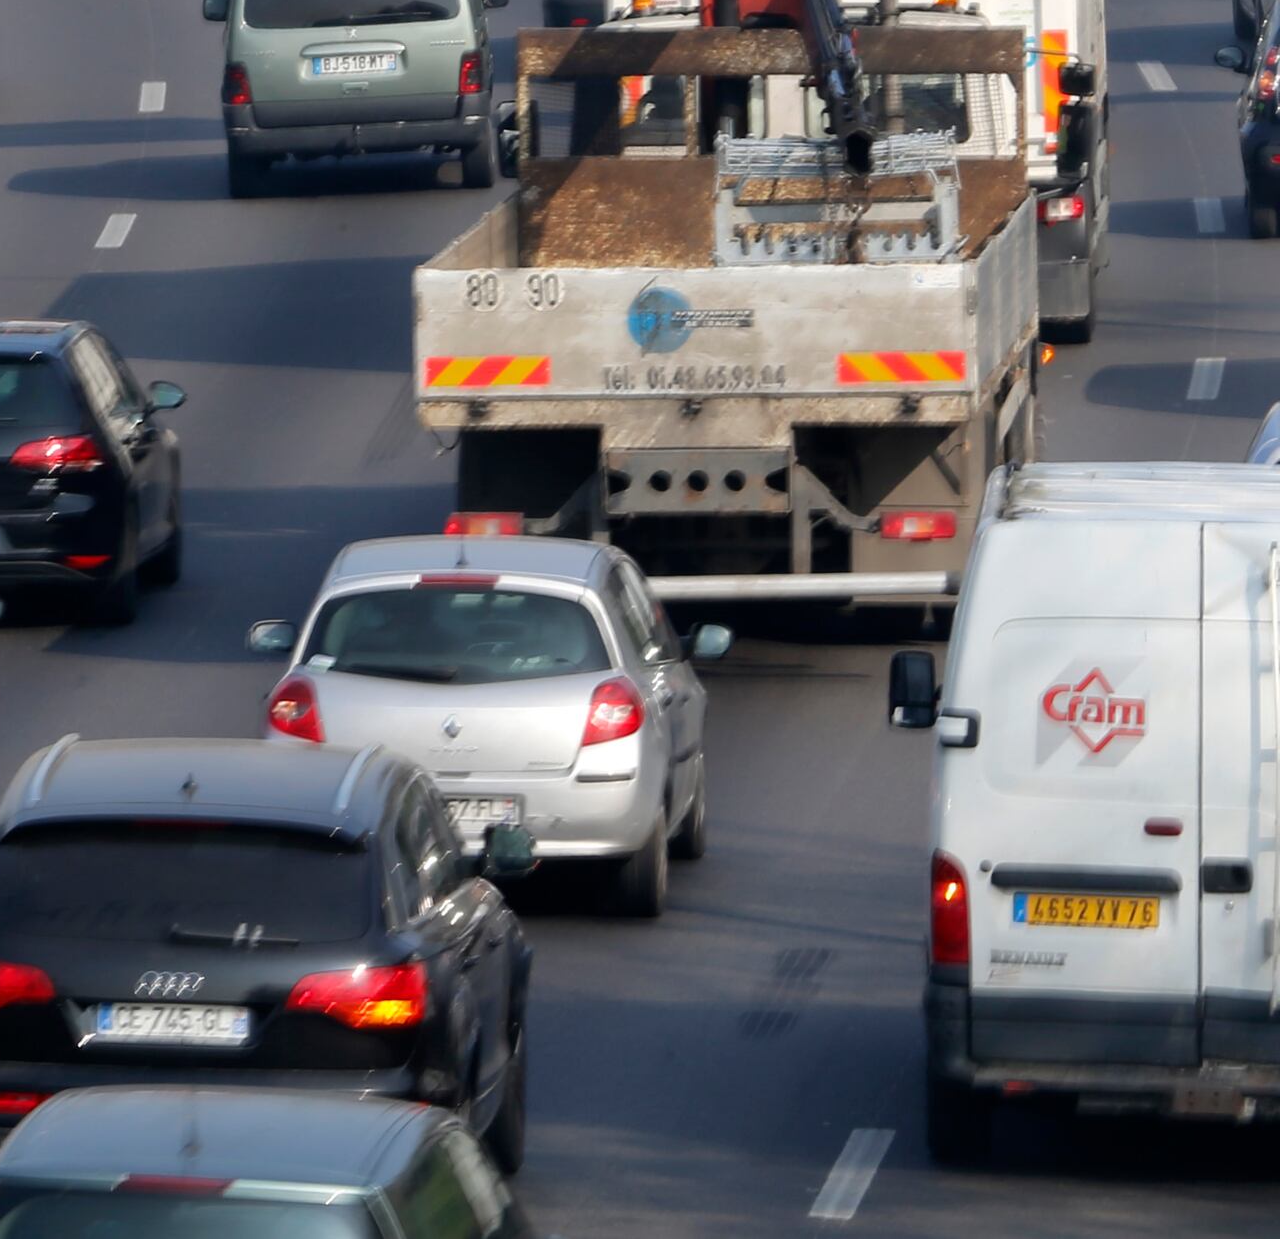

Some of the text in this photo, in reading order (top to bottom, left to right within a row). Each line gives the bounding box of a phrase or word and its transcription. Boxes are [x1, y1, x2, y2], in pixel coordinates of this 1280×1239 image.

[466, 273, 559, 307] 80 90
[1042, 683, 1146, 725] Cram
[1034, 896, 1153, 923] 4652 XV 76
